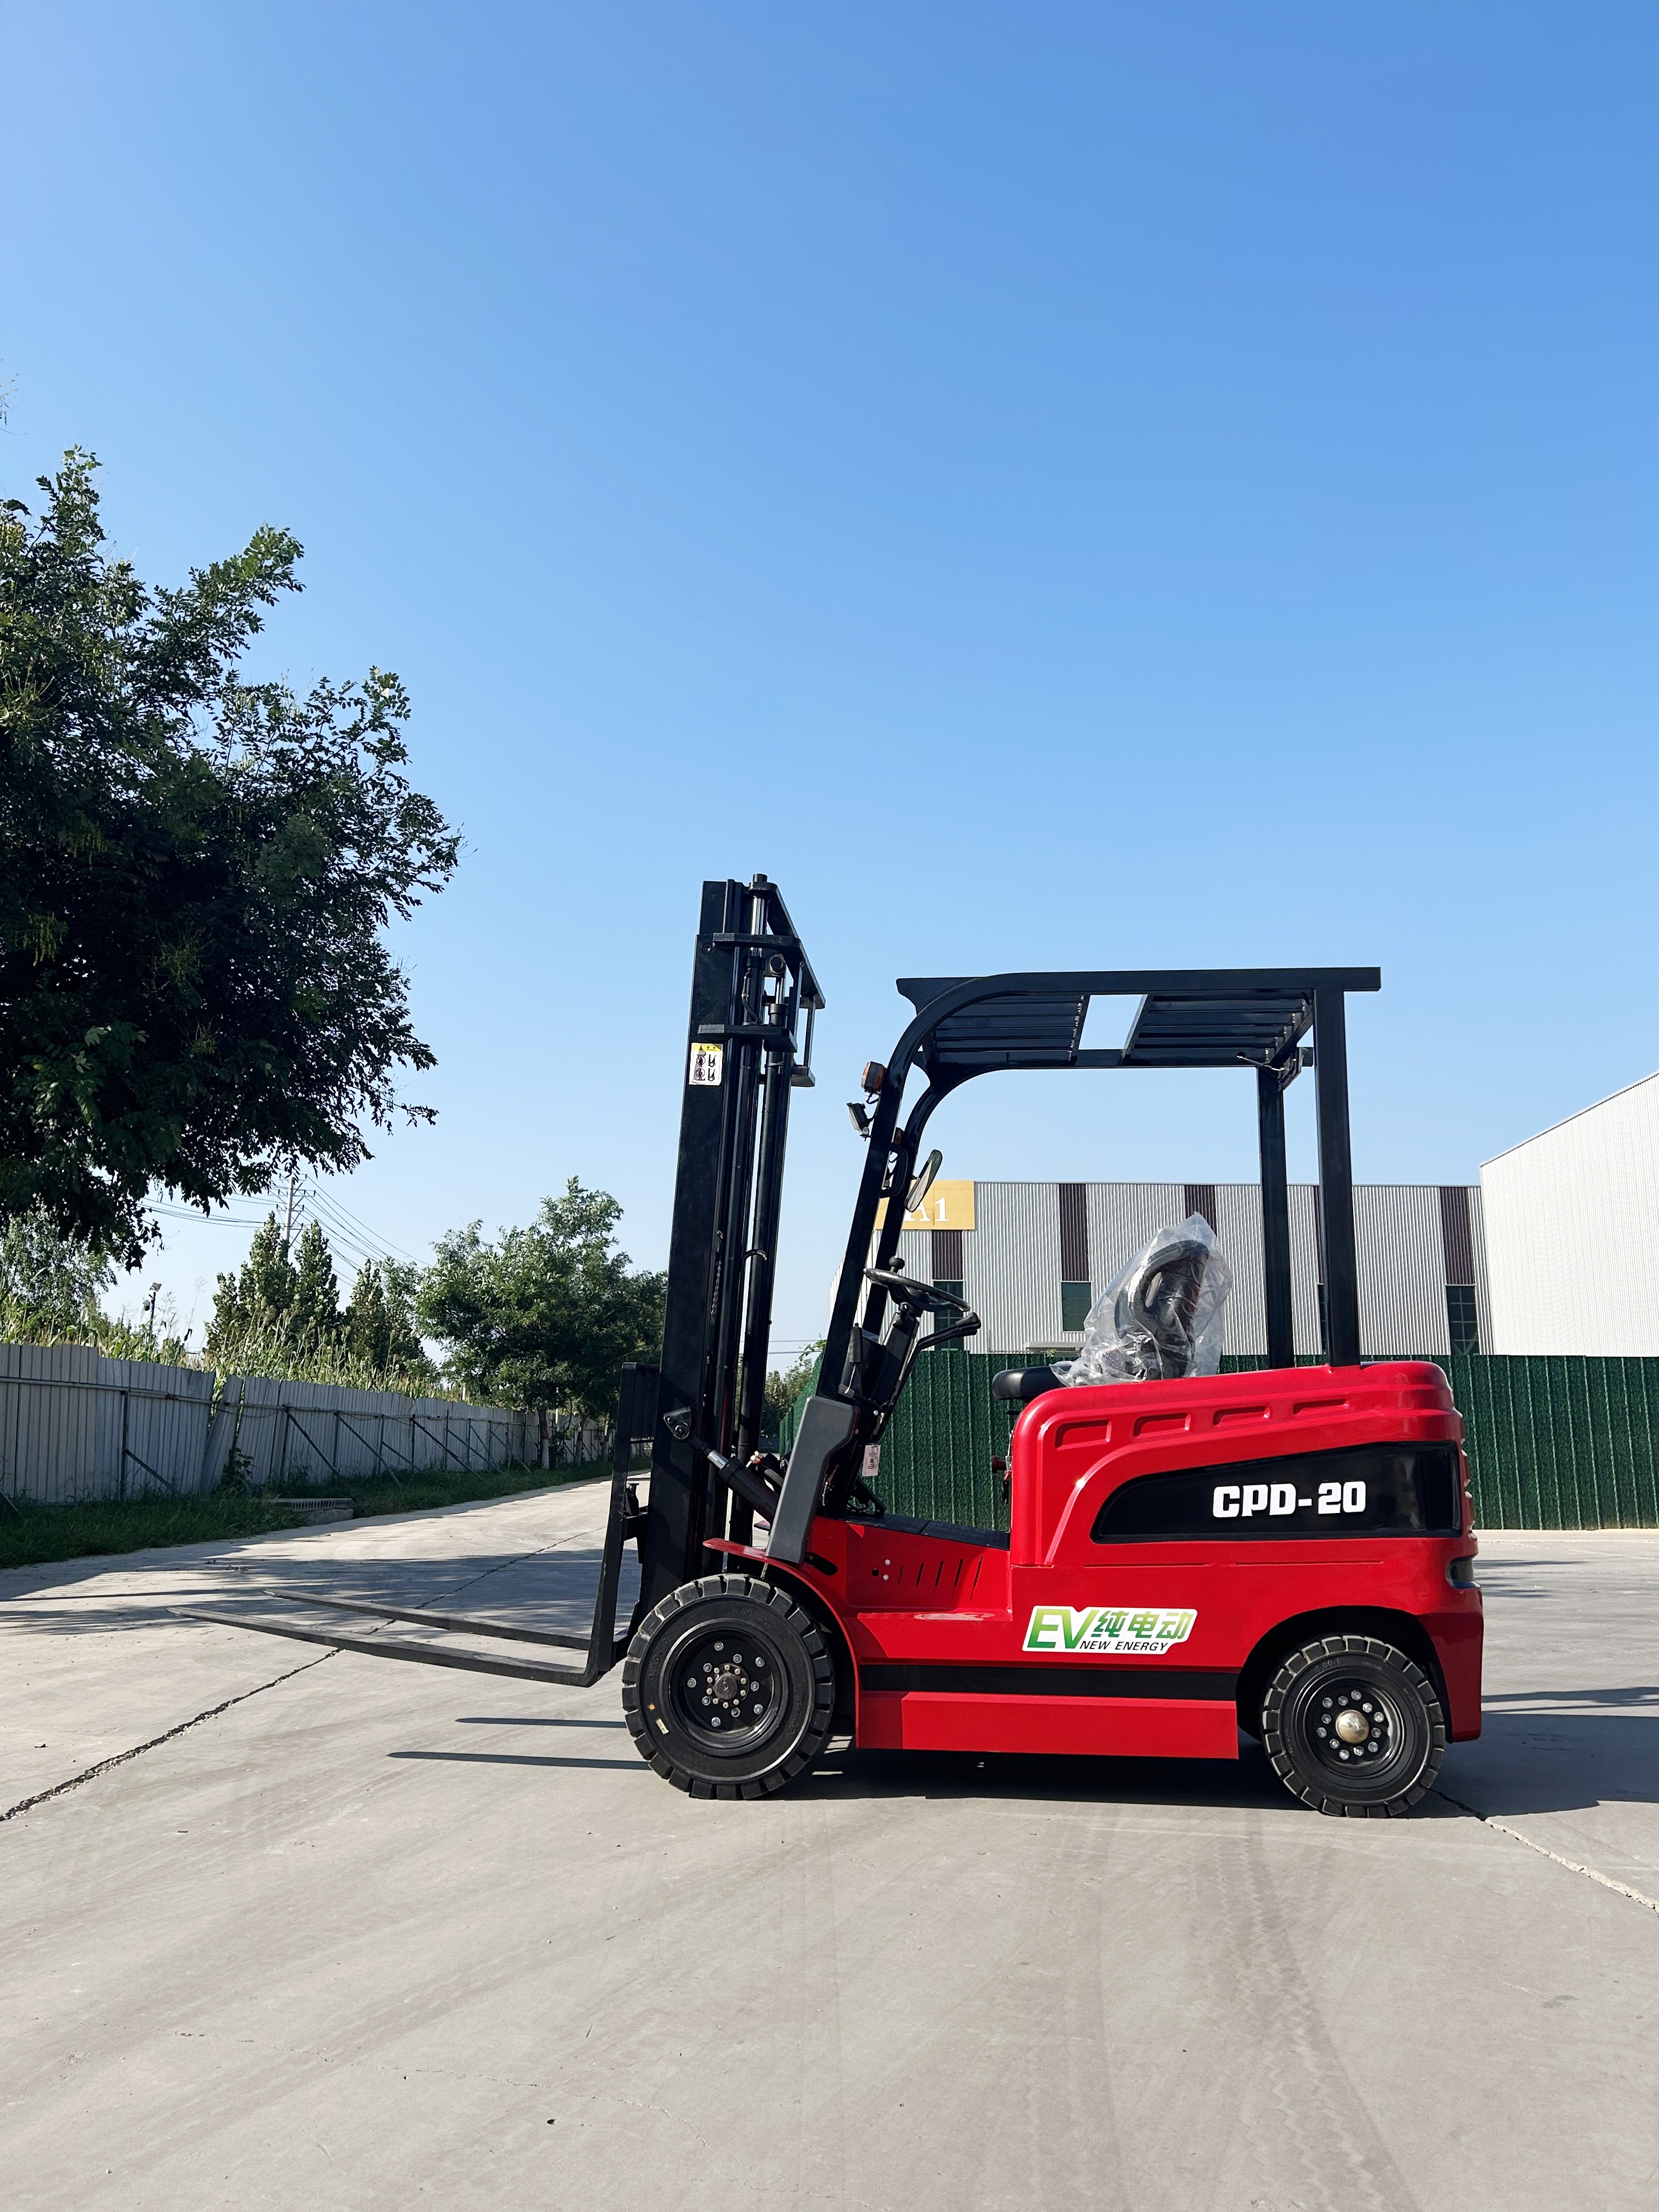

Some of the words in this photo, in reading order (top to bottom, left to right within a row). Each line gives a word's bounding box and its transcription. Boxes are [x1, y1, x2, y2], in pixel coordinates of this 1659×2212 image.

[903, 1197, 949, 1222] A1
[1213, 1480, 1366, 1518] CPD-20
[1027, 1608, 1099, 1649] EV
[1091, 1610, 1194, 1639] 纯电动
[1079, 1641, 1112, 1650] NEW
[1115, 1641, 1169, 1651] ENERGY
